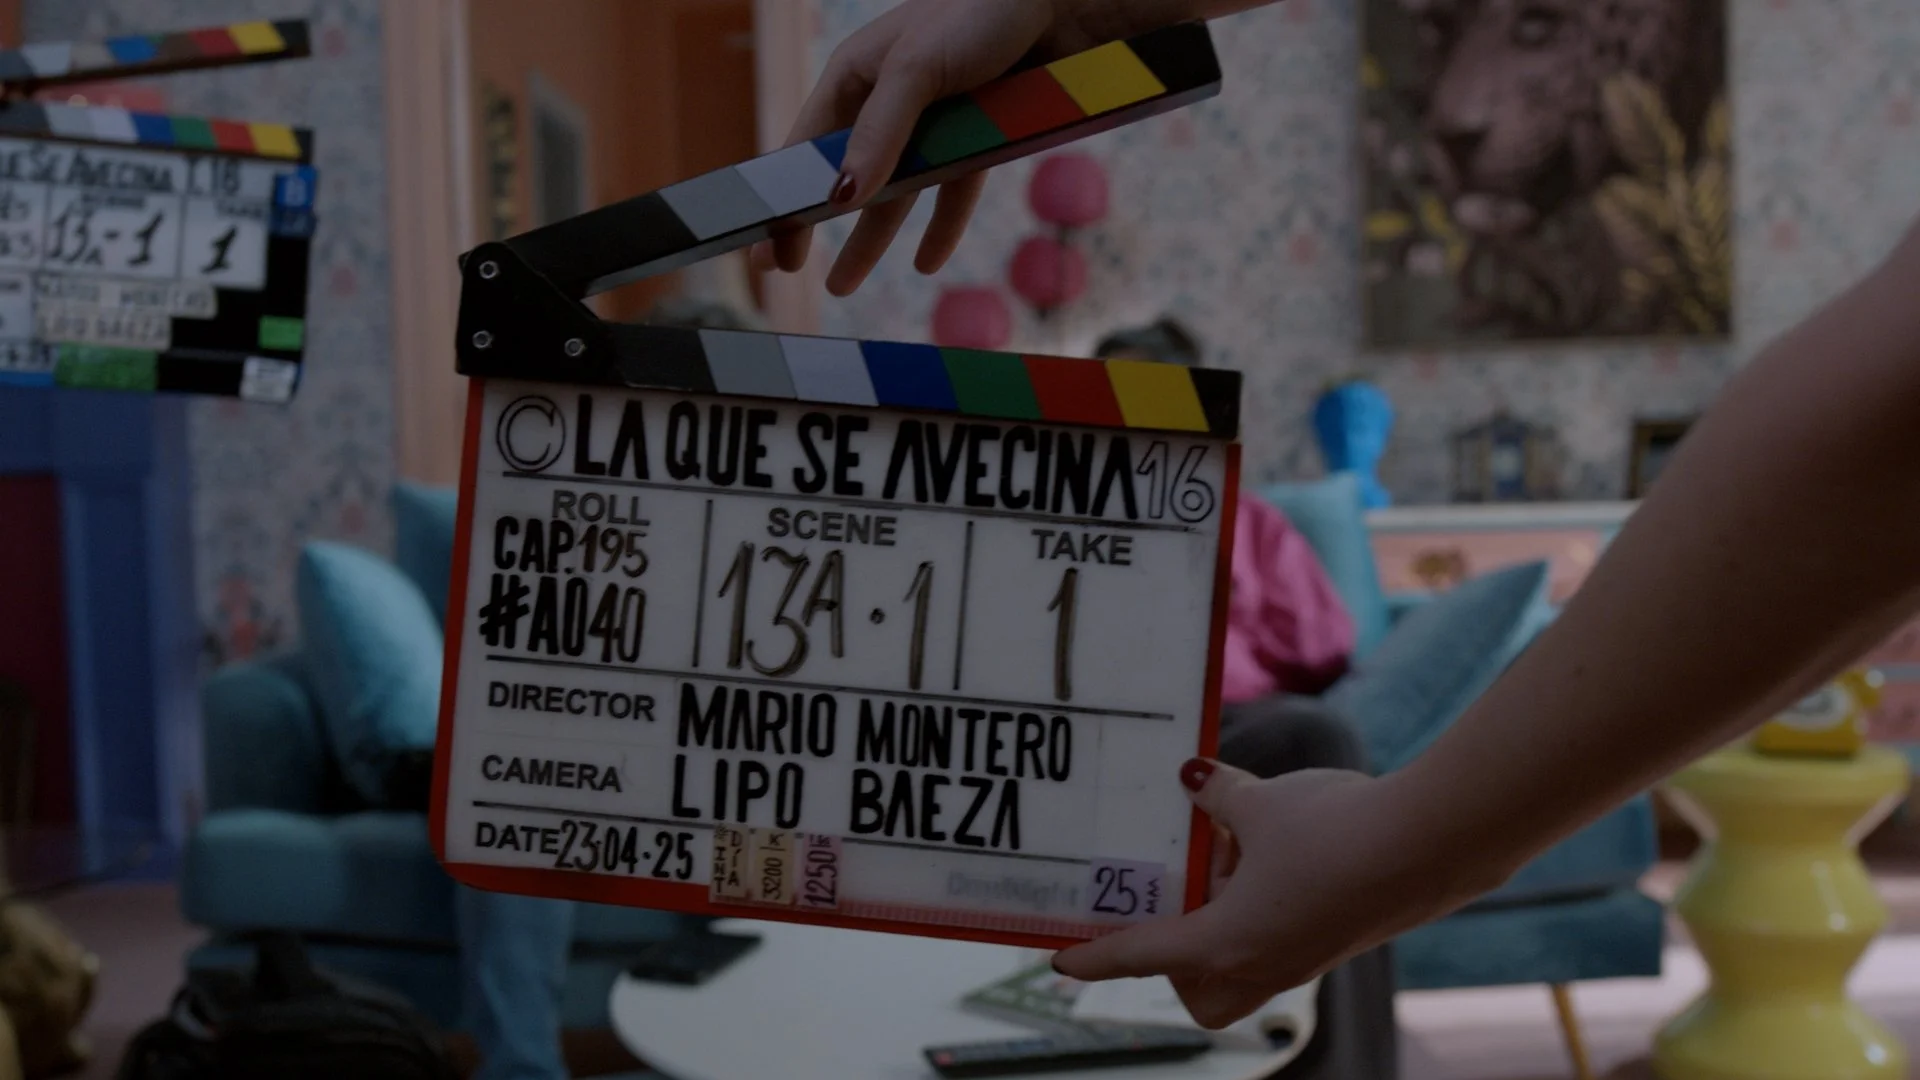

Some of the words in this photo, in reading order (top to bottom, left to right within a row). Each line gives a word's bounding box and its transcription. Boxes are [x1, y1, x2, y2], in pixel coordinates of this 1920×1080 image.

[203, 225, 237, 274] 1
[574, 393, 650, 480] LA
[665, 400, 778, 488] QUE
[793, 411, 869, 497] SE
[882, 419, 1138, 519] AVECINA
[1137, 440, 1215, 523] 16
[552, 488, 651, 527] ROLL
[767, 507, 898, 546] SCENE
[1031, 528, 1133, 566] TAKE
[1047, 566, 1080, 701] 1
[488, 680, 656, 723] DIRECTOR
[677, 682, 838, 758] MARIO
[856, 698, 1072, 783] MONTERO
[481, 754, 624, 793] CAMERA
[672, 753, 805, 829] LIPO
[850, 768, 1020, 850] BAEZA
[475, 821, 561, 854] DATE
[761, 856, 783, 900] 3200
[803, 849, 837, 906] 1250
[1092, 866, 1137, 916] 25
